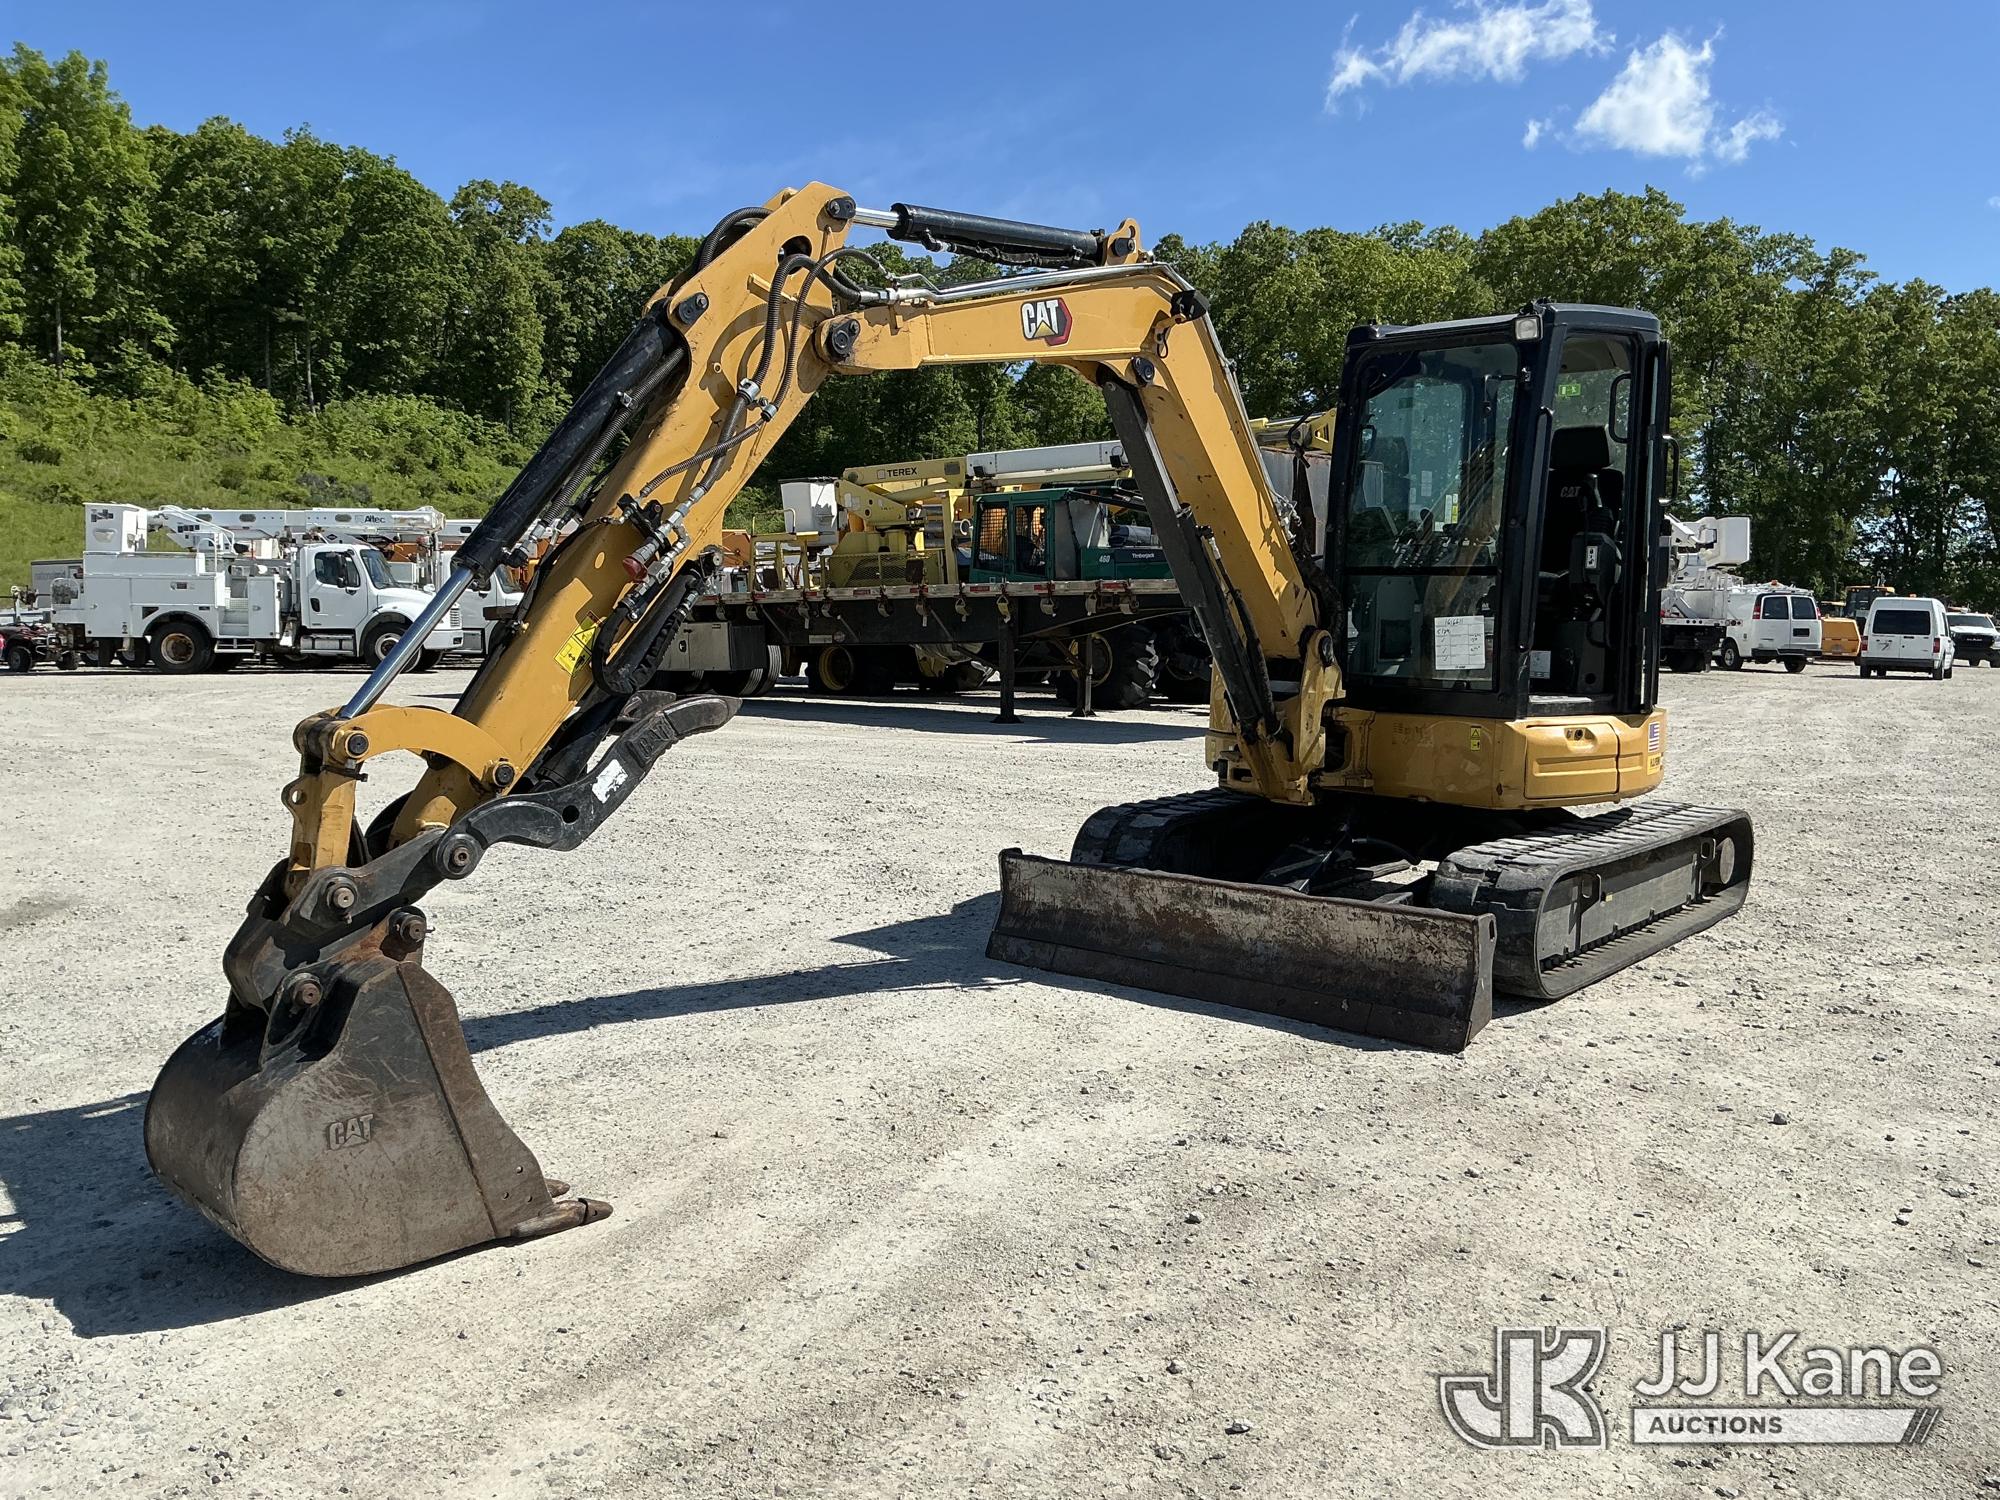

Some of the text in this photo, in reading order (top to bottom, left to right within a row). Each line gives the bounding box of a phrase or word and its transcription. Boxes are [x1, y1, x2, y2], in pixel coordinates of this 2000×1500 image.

[1021, 299, 1059, 339] CAT
[887, 467, 918, 477] TEREX
[1560, 486, 1581, 498] CAT
[364, 514, 386, 524] Altec
[328, 1113, 374, 1151] CAT
